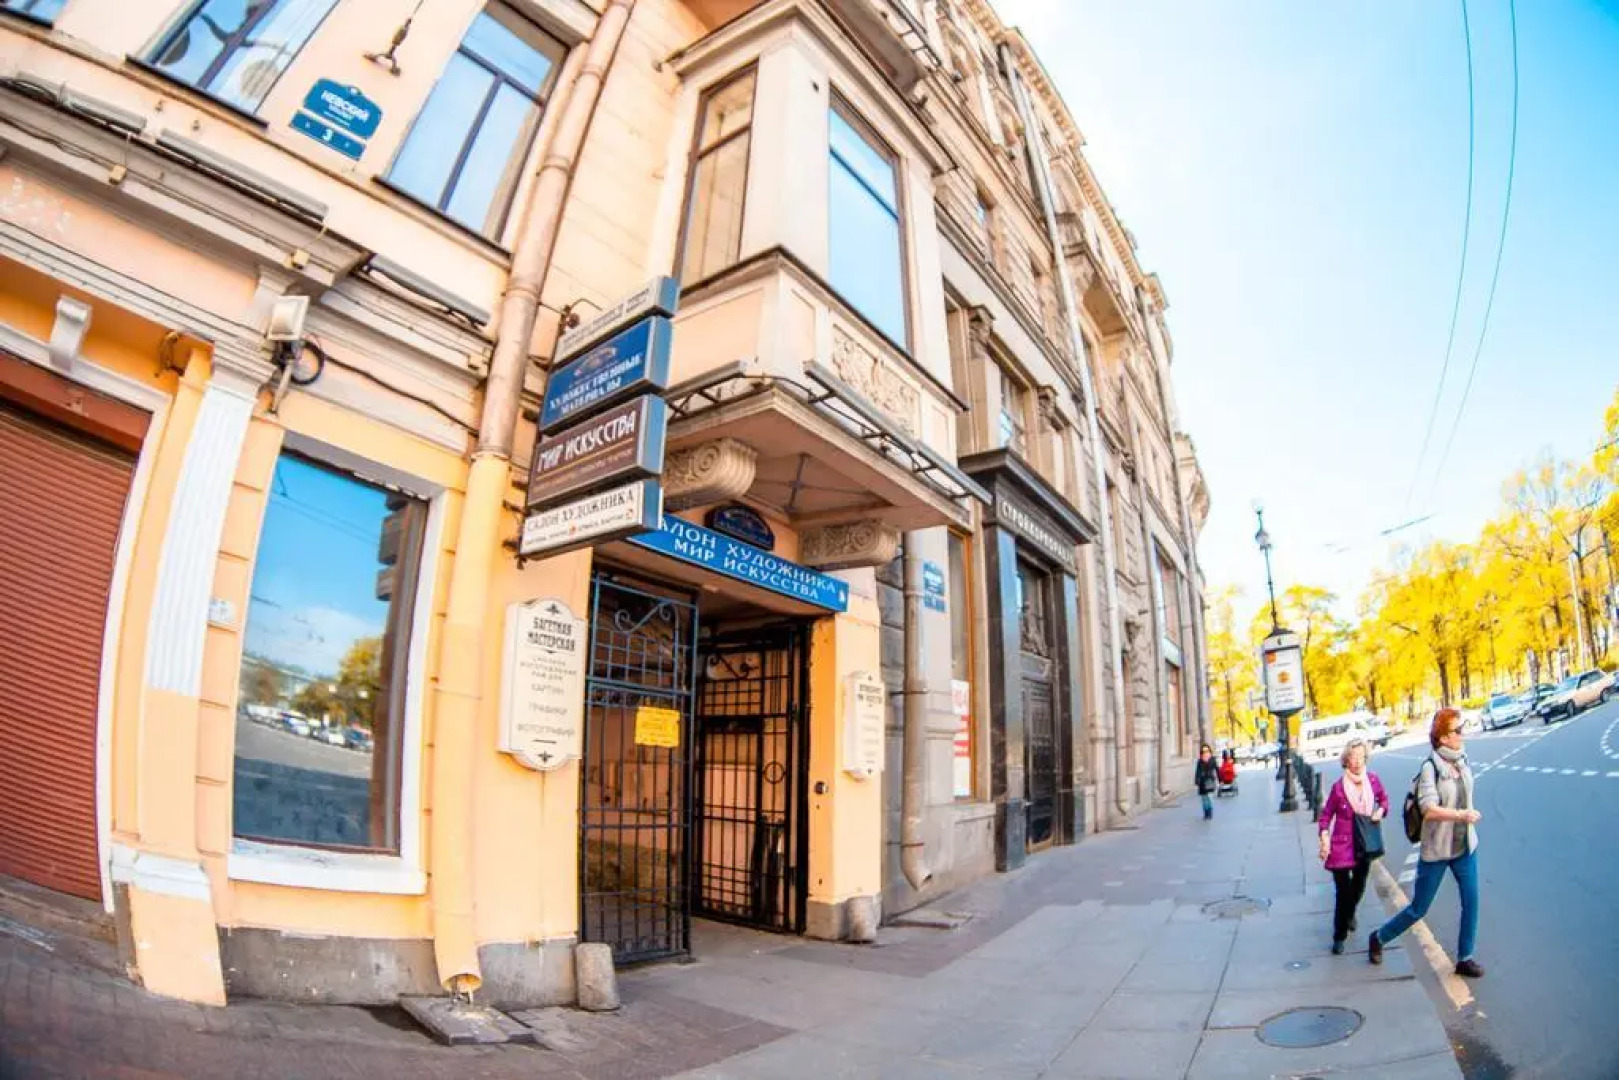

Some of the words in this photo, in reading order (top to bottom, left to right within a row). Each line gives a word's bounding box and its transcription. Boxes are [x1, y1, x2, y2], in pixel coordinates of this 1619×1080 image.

[322, 129, 333, 141] 3
[565, 410, 637, 461] ИСКУССТВА
[660, 517, 717, 549] АЛОН
[727, 542, 836, 594] ХУДОЖНИКА
[674, 538, 716, 562] МИР
[723, 557, 819, 600] ИСКУССТВА
